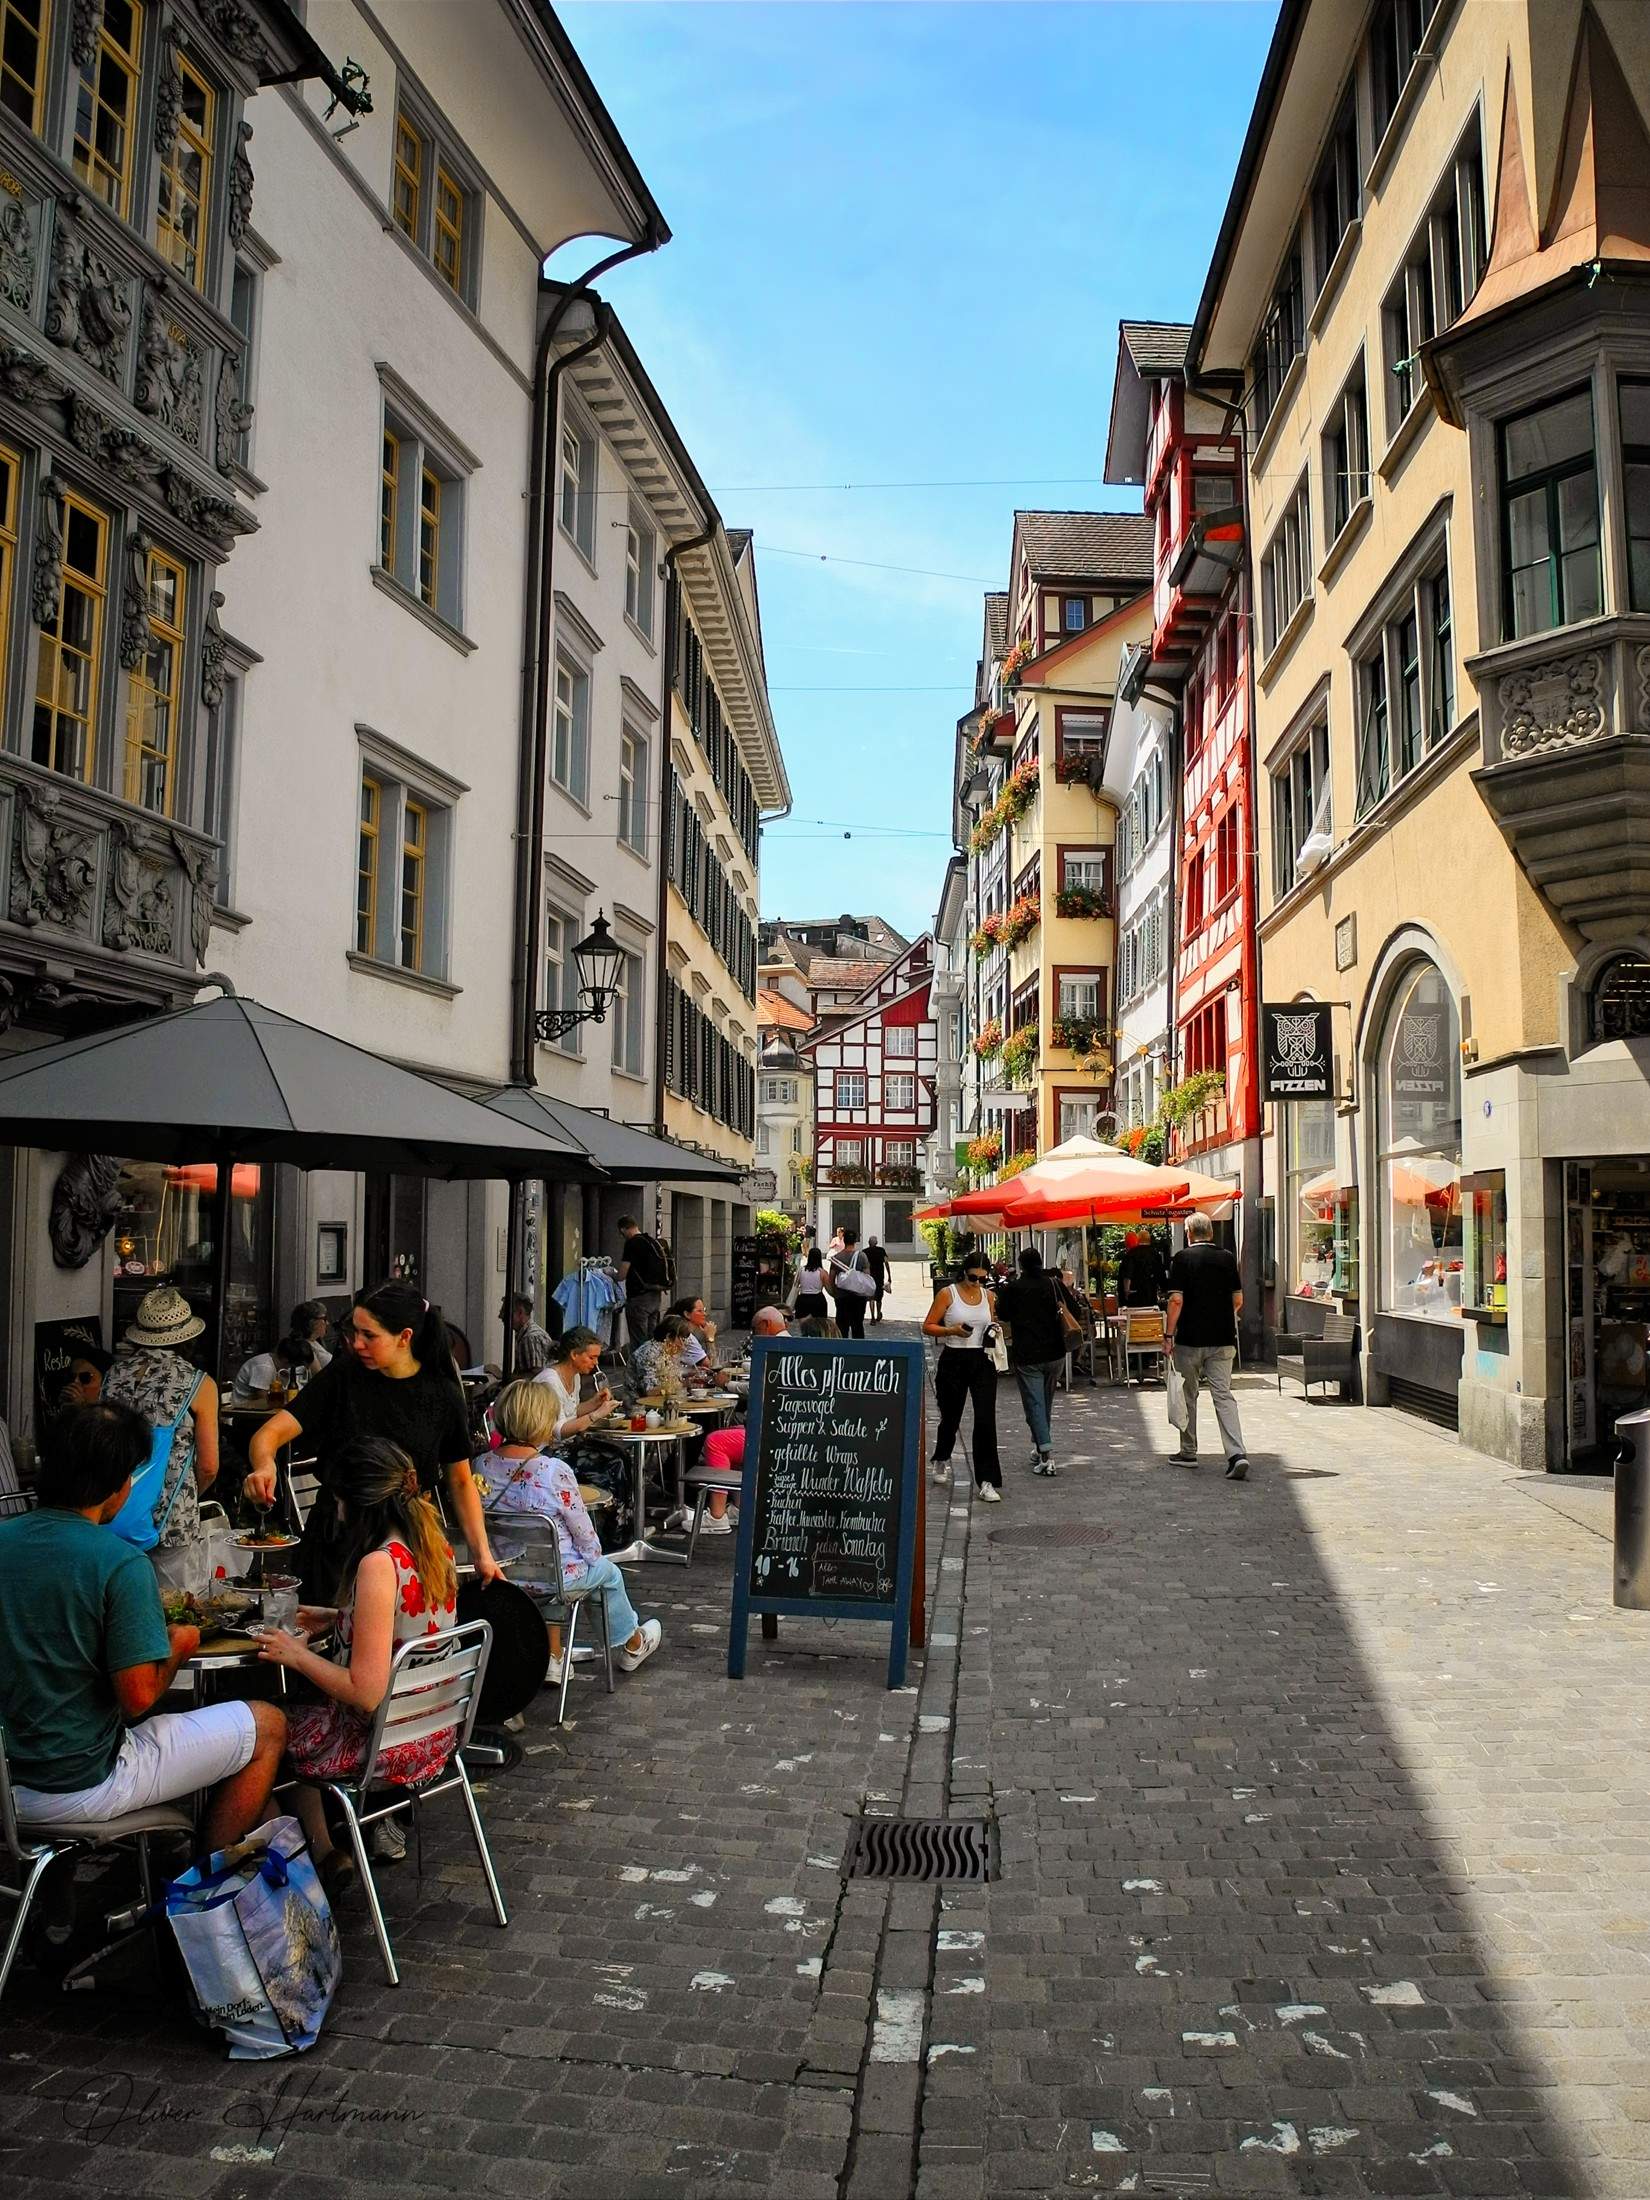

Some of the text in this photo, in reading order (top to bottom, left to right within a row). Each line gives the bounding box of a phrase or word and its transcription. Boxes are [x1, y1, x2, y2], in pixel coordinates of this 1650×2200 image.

[1270, 1079, 1326, 1092] FIZZEN
[768, 1354, 900, 1398] Alles pflanzlich
[777, 1393, 836, 1424] Tagesvogel
[776, 1416, 868, 1441] Suppen & Salate
[771, 1443, 859, 1472] gefüllte Wraps
[800, 1466, 840, 1492] Wunder
[843, 1466, 893, 1502] Waffeln
[770, 1494, 803, 1511] Kuchen
[839, 1510, 887, 1533] Kombucha
[760, 1526, 808, 1553] Brunch
[839, 1531, 886, 1570] Sonntag
